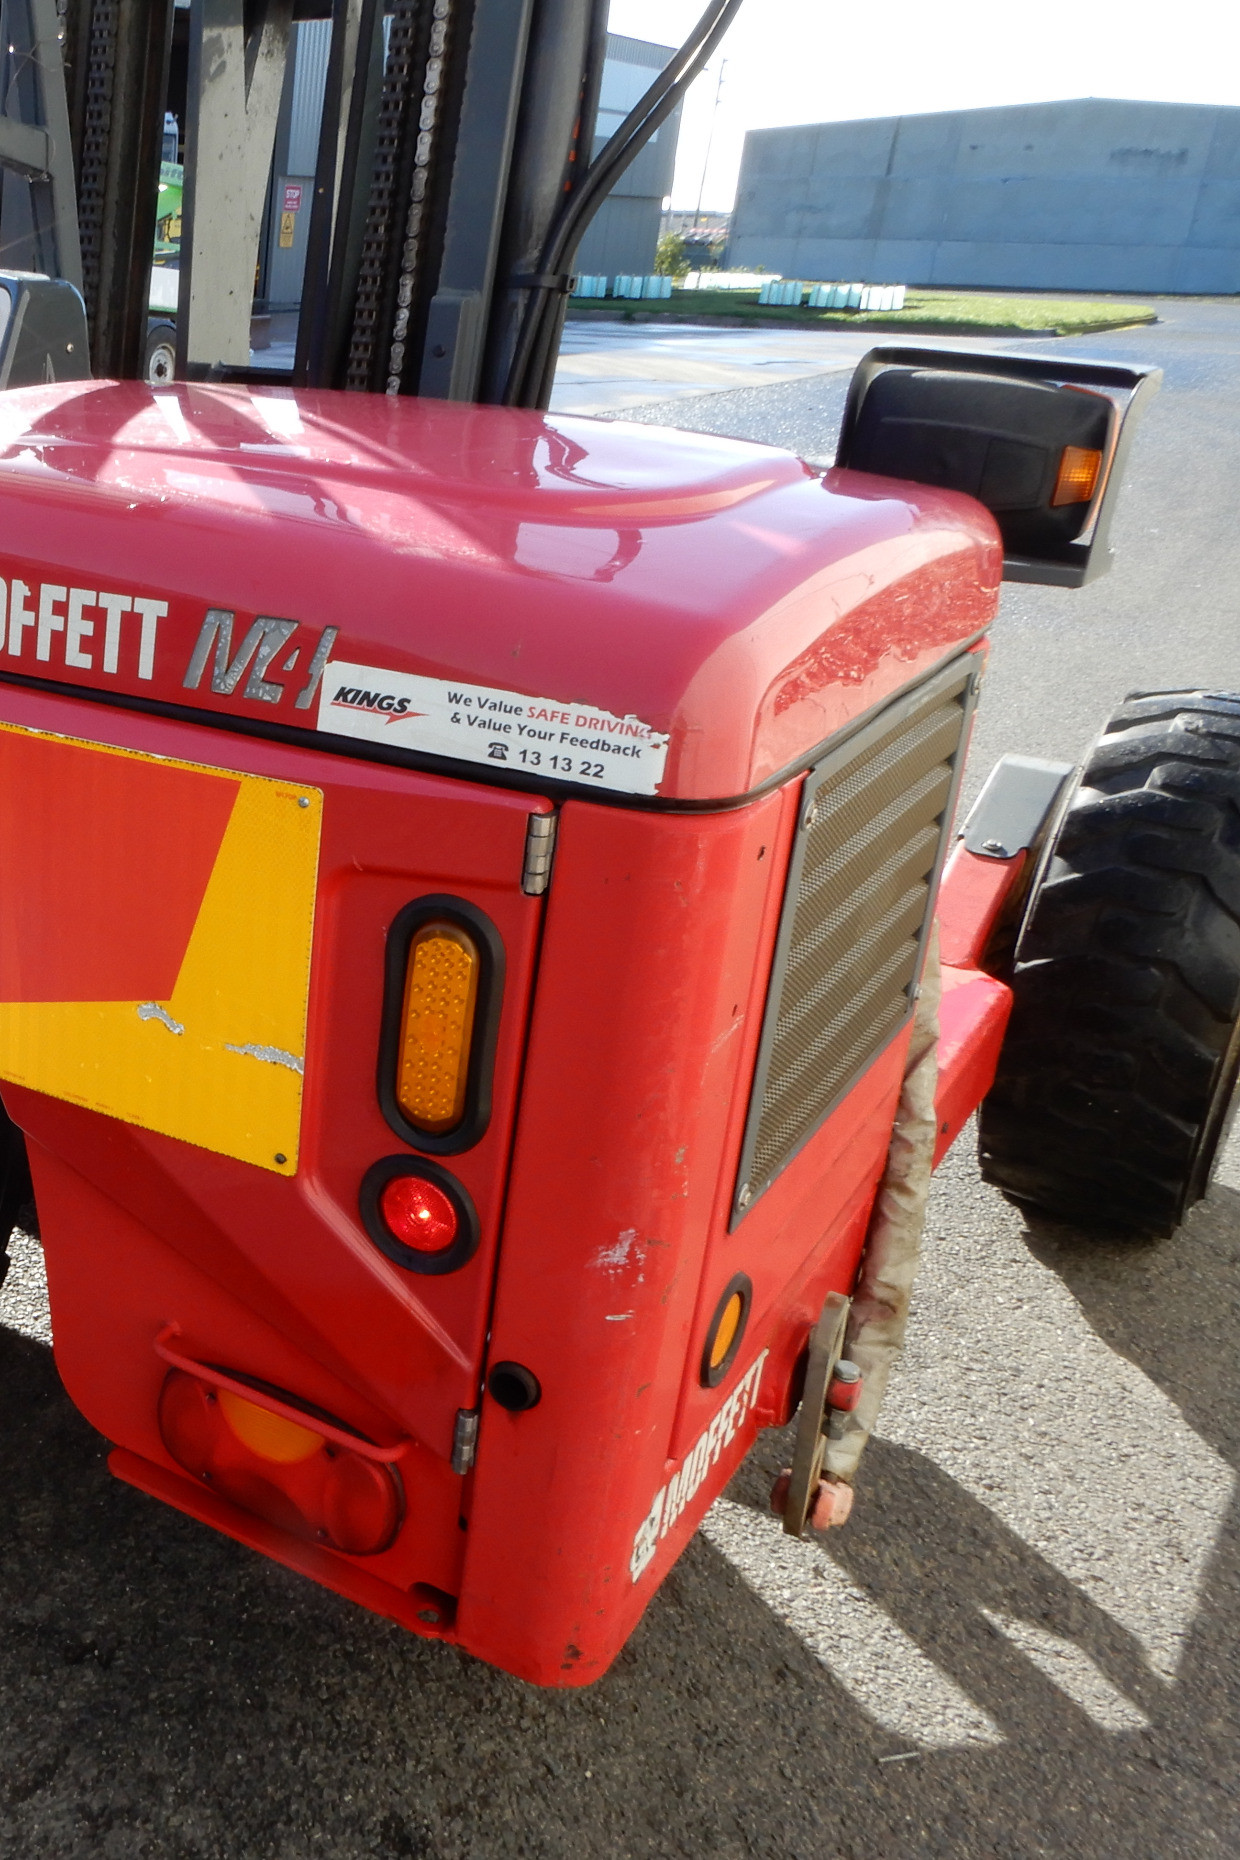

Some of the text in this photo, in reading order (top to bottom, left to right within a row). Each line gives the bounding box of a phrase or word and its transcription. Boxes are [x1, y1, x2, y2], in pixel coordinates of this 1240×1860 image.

[286, 189, 300, 199] STOP
[333, 686, 412, 714] KINGS
[447, 691, 472, 707] We
[477, 696, 523, 716] Value
[526, 706, 571, 725] SAFE
[450, 712, 642, 759] & Value Your Feedback
[518, 749, 605, 779] 13 13 22
[661, 1348, 770, 1539] MOFFETT
